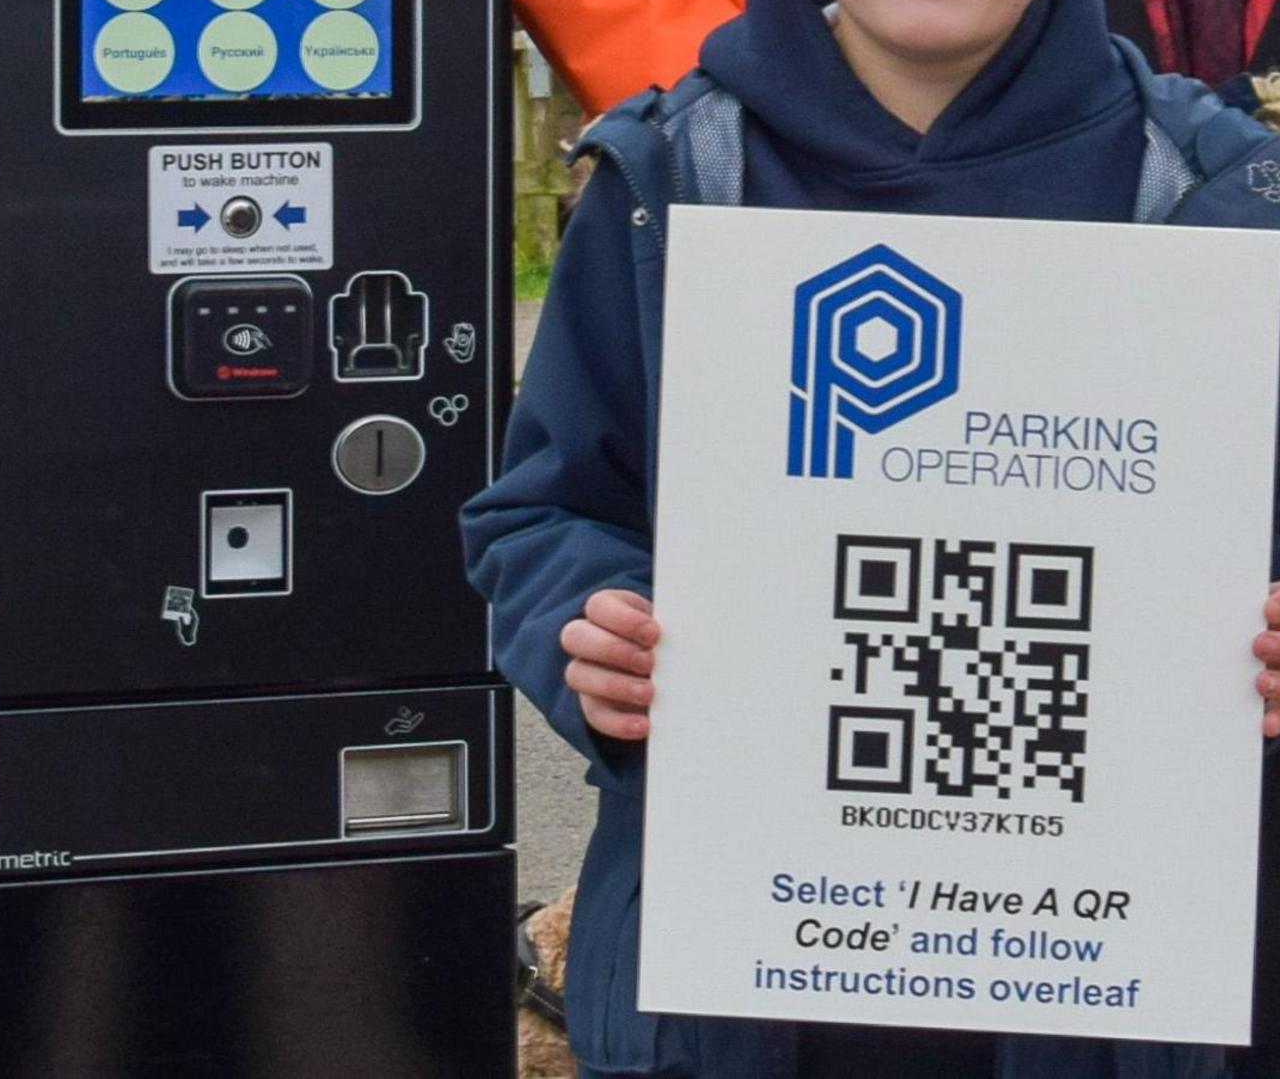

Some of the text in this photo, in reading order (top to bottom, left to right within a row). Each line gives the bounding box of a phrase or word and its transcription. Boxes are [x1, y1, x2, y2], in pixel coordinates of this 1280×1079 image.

[211, 45, 264, 59] Русский
[162, 151, 321, 171] PUSH BUTTON
[183, 174, 299, 188] to wake machine
[173, 248, 193, 257] may
[249, 245, 274, 254] when
[964, 411, 1159, 455] PARKING
[880, 447, 1157, 495] OPERATIONS
[771, 873, 887, 909] Select
[930, 882, 1024, 915] Have
[1032, 886, 1061, 917] A
[1070, 888, 1132, 921] QR
[794, 919, 1104, 963] Code’ and follow
[754, 961, 1140, 1009] instructions overleaf
